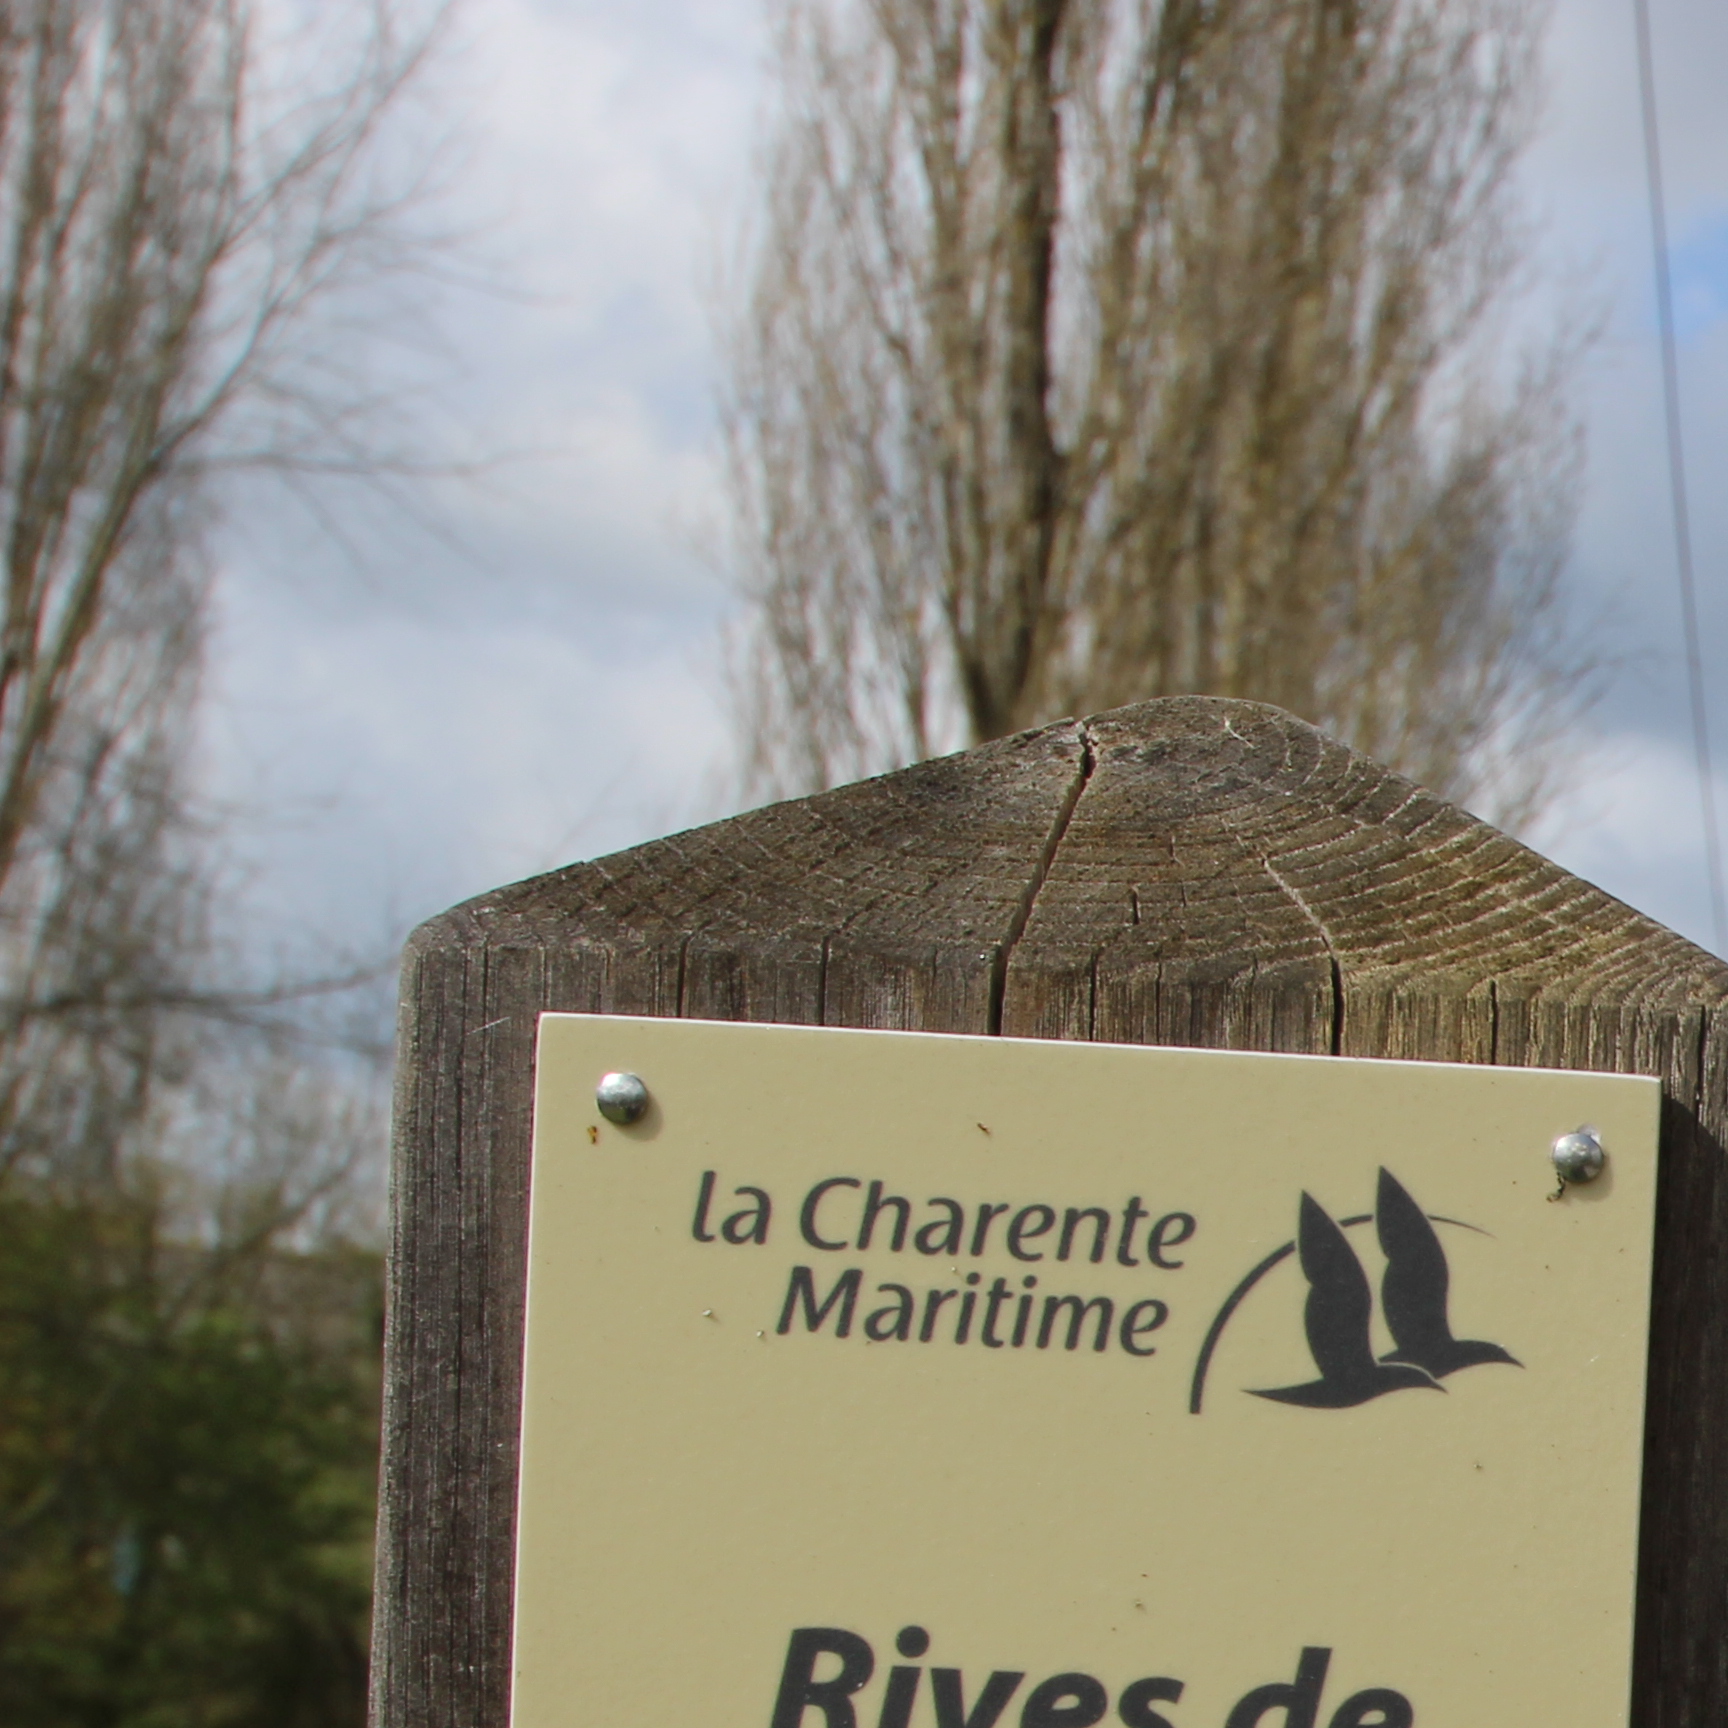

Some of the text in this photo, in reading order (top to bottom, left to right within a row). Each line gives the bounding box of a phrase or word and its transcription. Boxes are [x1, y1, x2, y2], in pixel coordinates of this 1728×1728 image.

[691, 1170, 1197, 1270] la Charente
[776, 1265, 1169, 1357] Maritime
